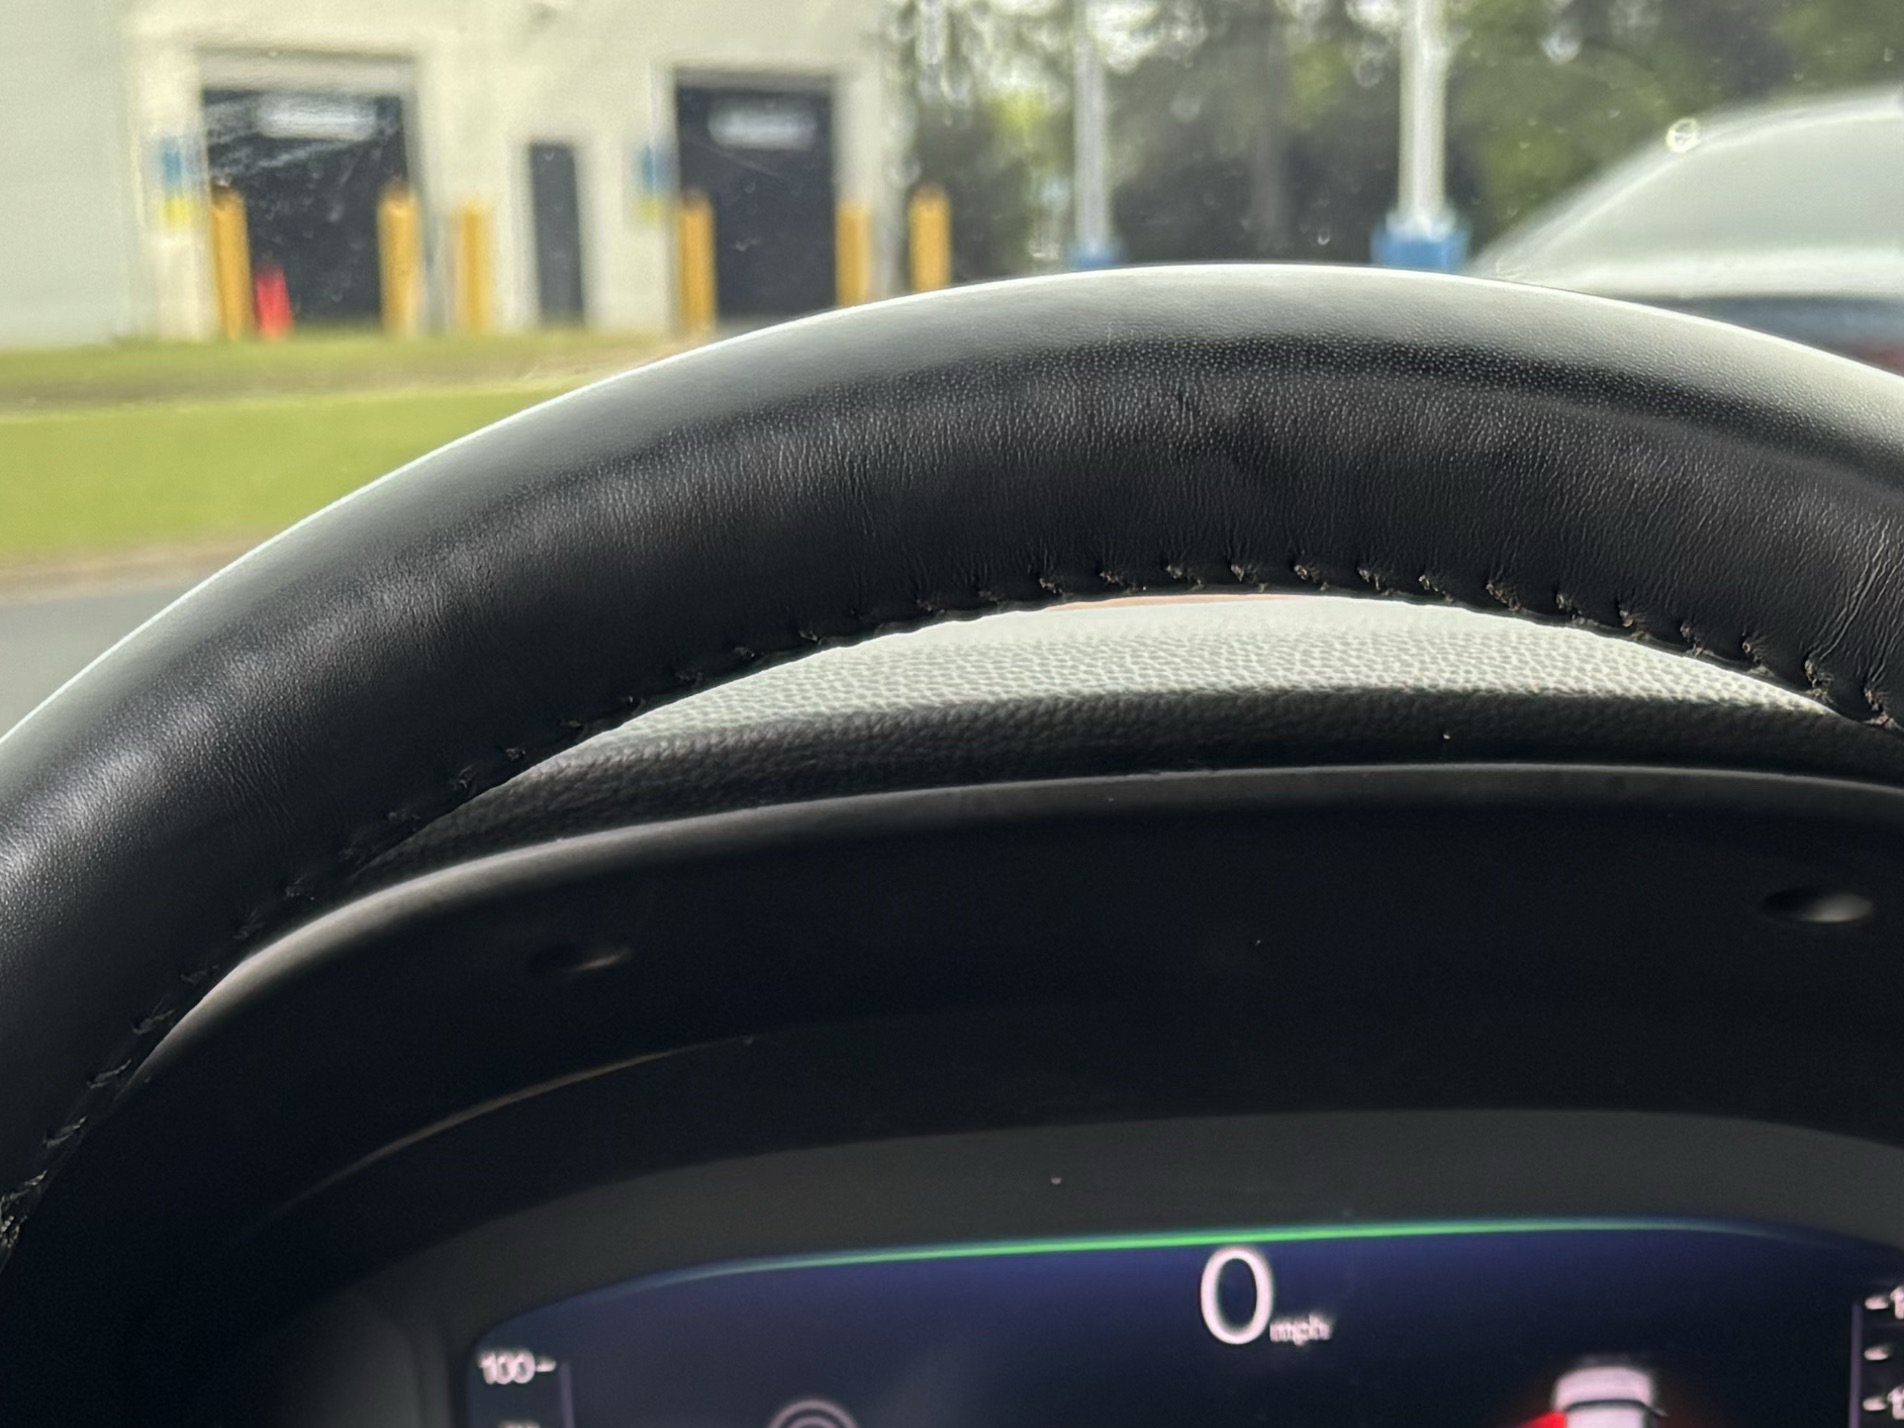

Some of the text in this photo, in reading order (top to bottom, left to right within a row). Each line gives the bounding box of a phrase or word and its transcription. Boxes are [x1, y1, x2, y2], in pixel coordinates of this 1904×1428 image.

[1200, 1246, 1333, 1346] 0 mph
[478, 1348, 537, 1385] 100
